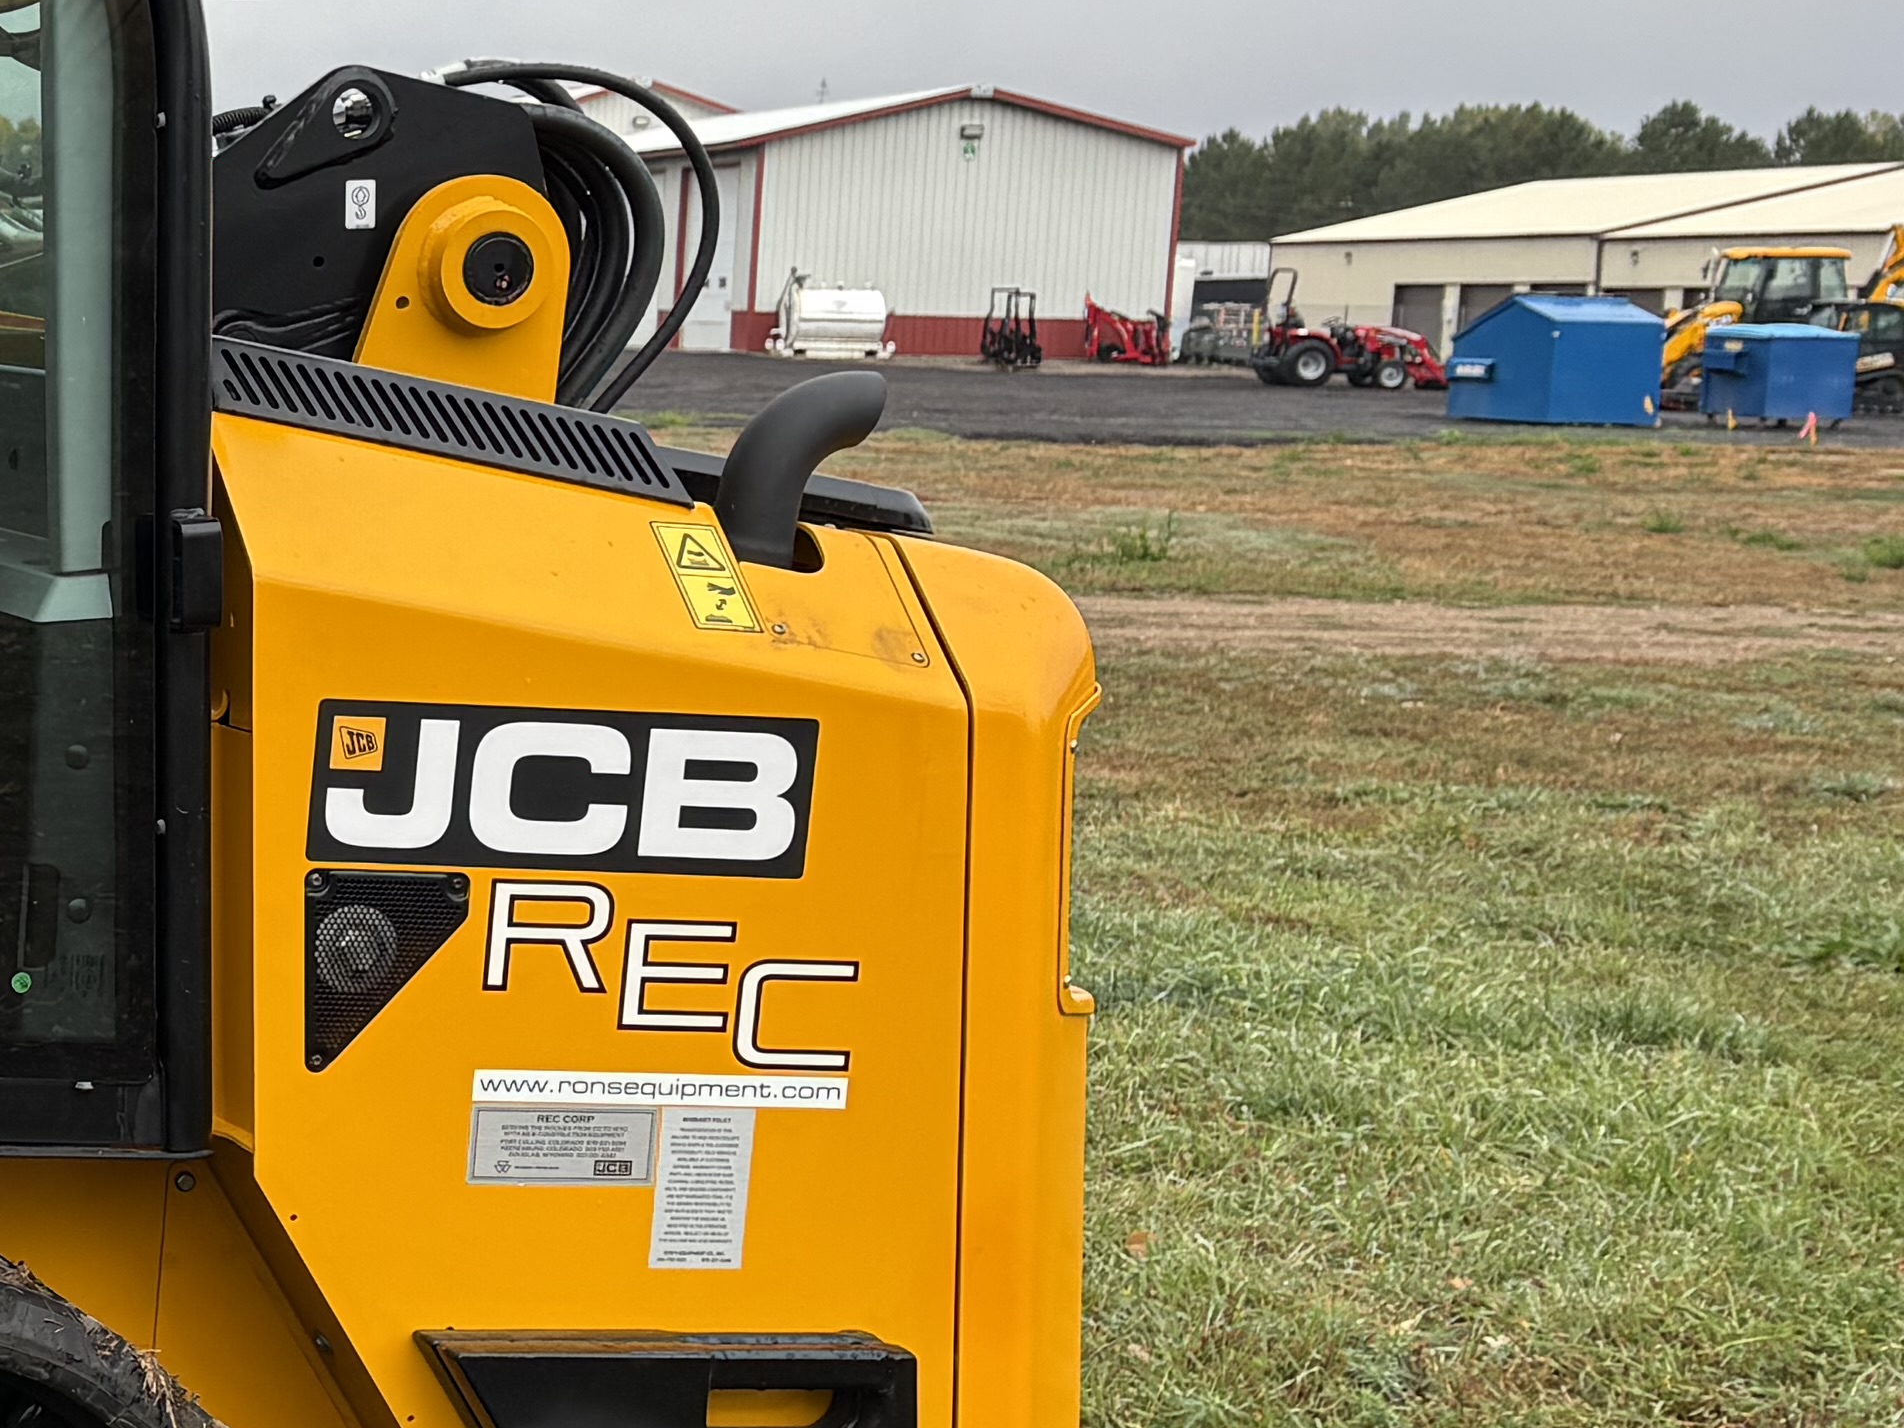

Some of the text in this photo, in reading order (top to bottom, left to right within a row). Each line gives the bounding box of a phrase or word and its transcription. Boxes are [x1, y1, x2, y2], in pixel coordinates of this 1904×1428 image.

[346, 730, 375, 755] JCB
[325, 719, 798, 861] JCB
[482, 878, 860, 1072] REC
[480, 1078, 842, 1101] www.ronsequipment.com
[537, 1114, 595, 1124] REC CORP
[596, 1161, 630, 1174] JCB
